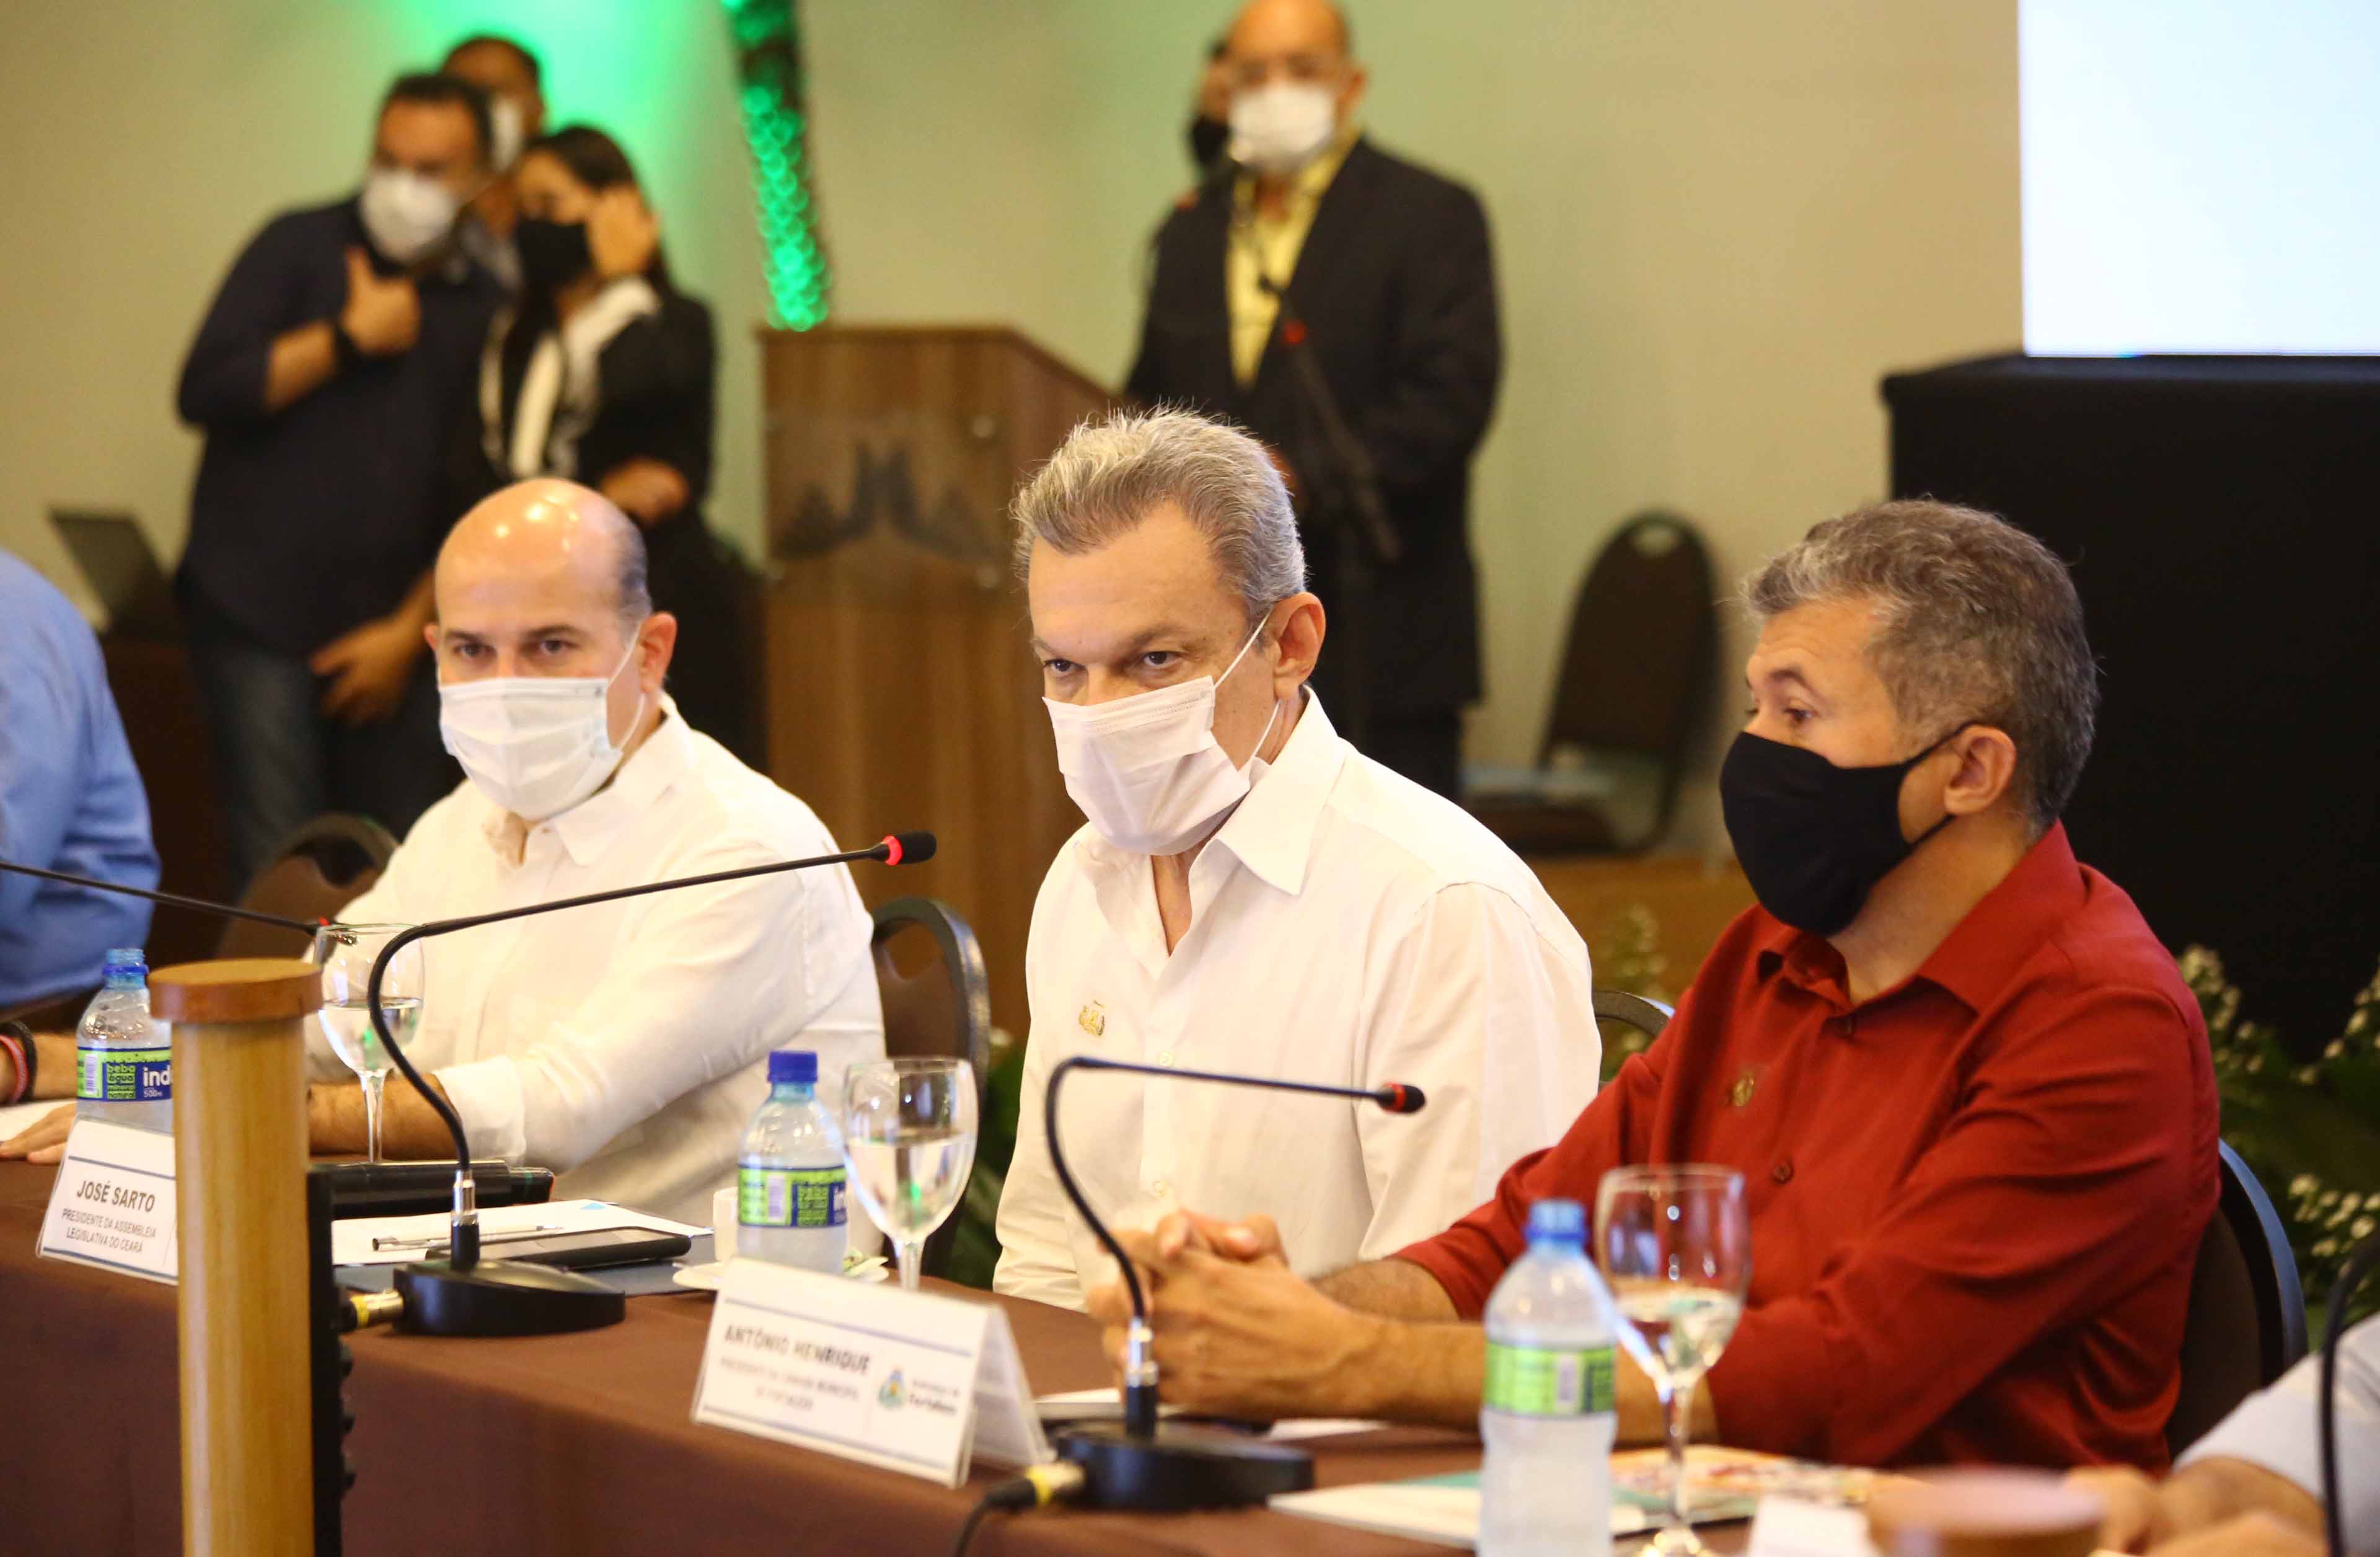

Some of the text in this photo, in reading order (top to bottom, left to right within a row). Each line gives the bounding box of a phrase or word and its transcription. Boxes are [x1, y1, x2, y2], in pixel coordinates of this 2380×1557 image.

[143, 1065, 171, 1086] ind
[77, 1180, 155, 1212] JOSÉ SARTO
[62, 1209, 103, 1228] PRESIDENTE
[104, 1217, 113, 1228] DA
[67, 1227, 108, 1245] LEGISLATIVA
[108, 1236, 118, 1248] DO
[794, 1341, 871, 1374] HENRIQUE
